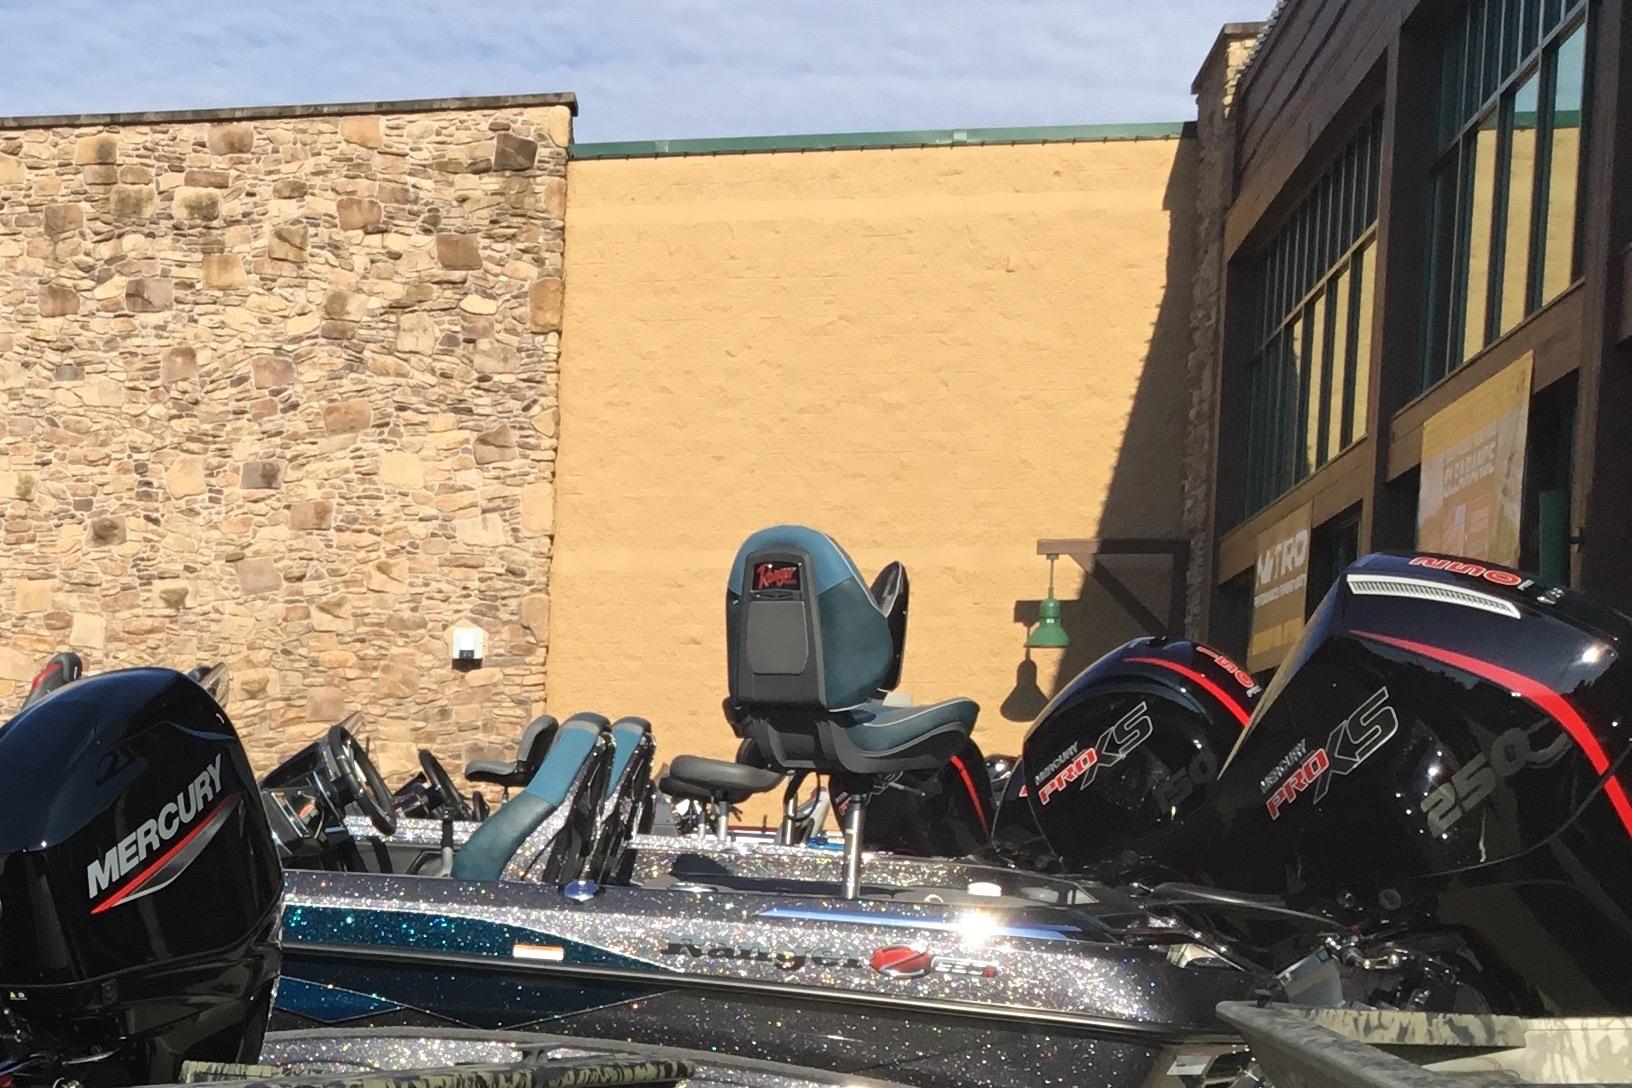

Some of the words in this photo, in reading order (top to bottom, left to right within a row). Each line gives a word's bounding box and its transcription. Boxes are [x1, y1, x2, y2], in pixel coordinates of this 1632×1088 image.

[1039, 748, 1098, 805] PRO
[1259, 738, 1306, 794] MERCURY
[1266, 748, 1329, 820] PRO
[87, 753, 222, 899] MERCURY
